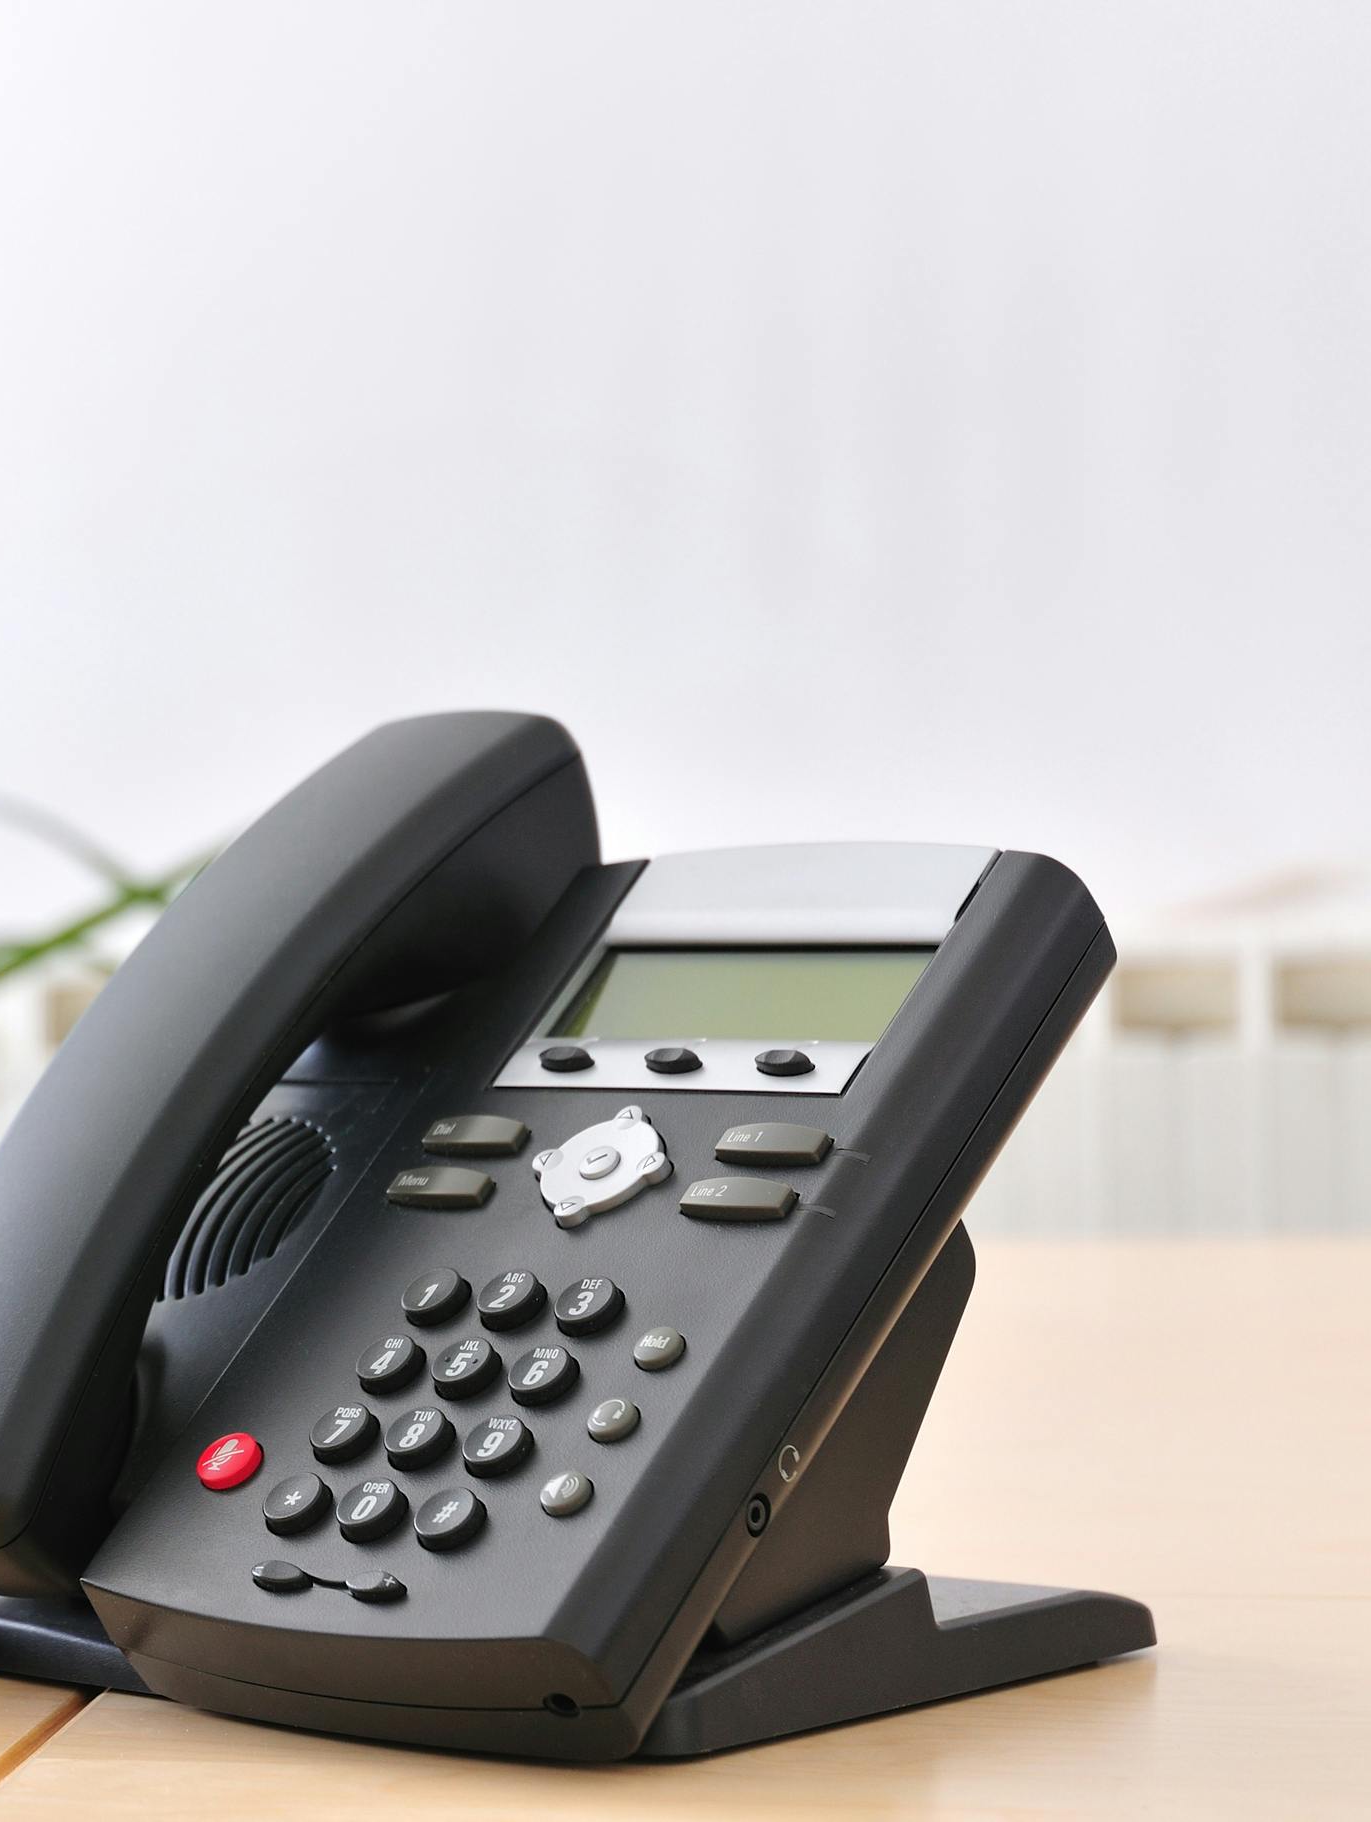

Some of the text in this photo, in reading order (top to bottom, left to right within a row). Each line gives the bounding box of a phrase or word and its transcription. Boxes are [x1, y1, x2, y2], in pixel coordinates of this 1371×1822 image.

[432, 1123, 457, 1136] Dial
[726, 1131, 764, 1143] Line 1
[398, 1175, 430, 1188] Menu
[690, 1184, 728, 1197] Line 2
[502, 1272, 526, 1284] ABC
[580, 1278, 603, 1290] DEF
[417, 1283, 439, 1307] 1
[487, 1284, 517, 1308] 2
[568, 1291, 595, 1316] 3
[384, 1338, 404, 1349] GHI
[459, 1340, 480, 1351] JKL
[639, 1334, 670, 1349] Hold
[533, 1348, 560, 1359] MNO
[370, 1350, 396, 1375] 4
[445, 1352, 474, 1377] 5
[522, 1360, 549, 1386] 6
[334, 1406, 362, 1419] PQRS
[413, 1410, 436, 1422] TUV
[488, 1417, 518, 1431] WXYZ
[323, 1420, 352, 1444] 7
[398, 1423, 426, 1448] 8
[476, 1431, 505, 1457] 9
[362, 1482, 390, 1494] OPER
[351, 1496, 378, 1520] 0
[432, 1501, 461, 1524] #
